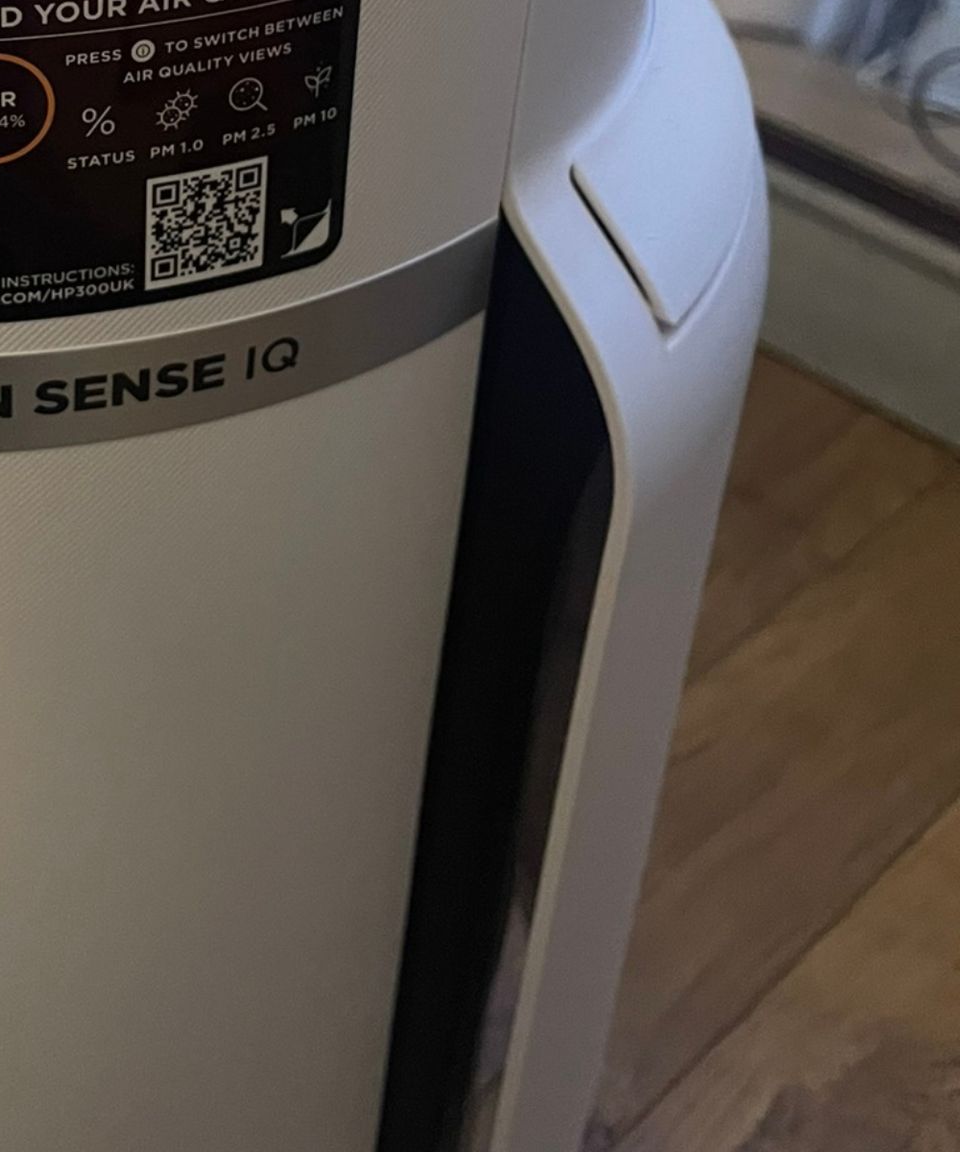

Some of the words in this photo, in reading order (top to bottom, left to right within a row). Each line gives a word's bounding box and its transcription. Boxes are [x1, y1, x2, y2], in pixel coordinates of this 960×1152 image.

[65, 49, 122, 66] PRESS
[165, 39, 188, 53] TO
[193, 26, 260, 49] SWITCH
[265, 6, 344, 36] BETWEEN
[123, 69, 153, 84] AIR
[159, 55, 234, 79] QUALITY
[239, 43, 292, 64] VIEWS
[293, 114, 316, 129] PM
[320, 107, 337, 122] 10
[222, 130, 246, 145] PM
[251, 123, 276, 139] 2.5
[67, 150, 136, 170] STATUS
[150, 144, 175, 159] PM
[181, 139, 204, 154] 1.0
[1, 263, 135, 289] INSTRUCTIONS:
[34, 354, 226, 414] SENSE
[245, 336, 300, 380] IQ
